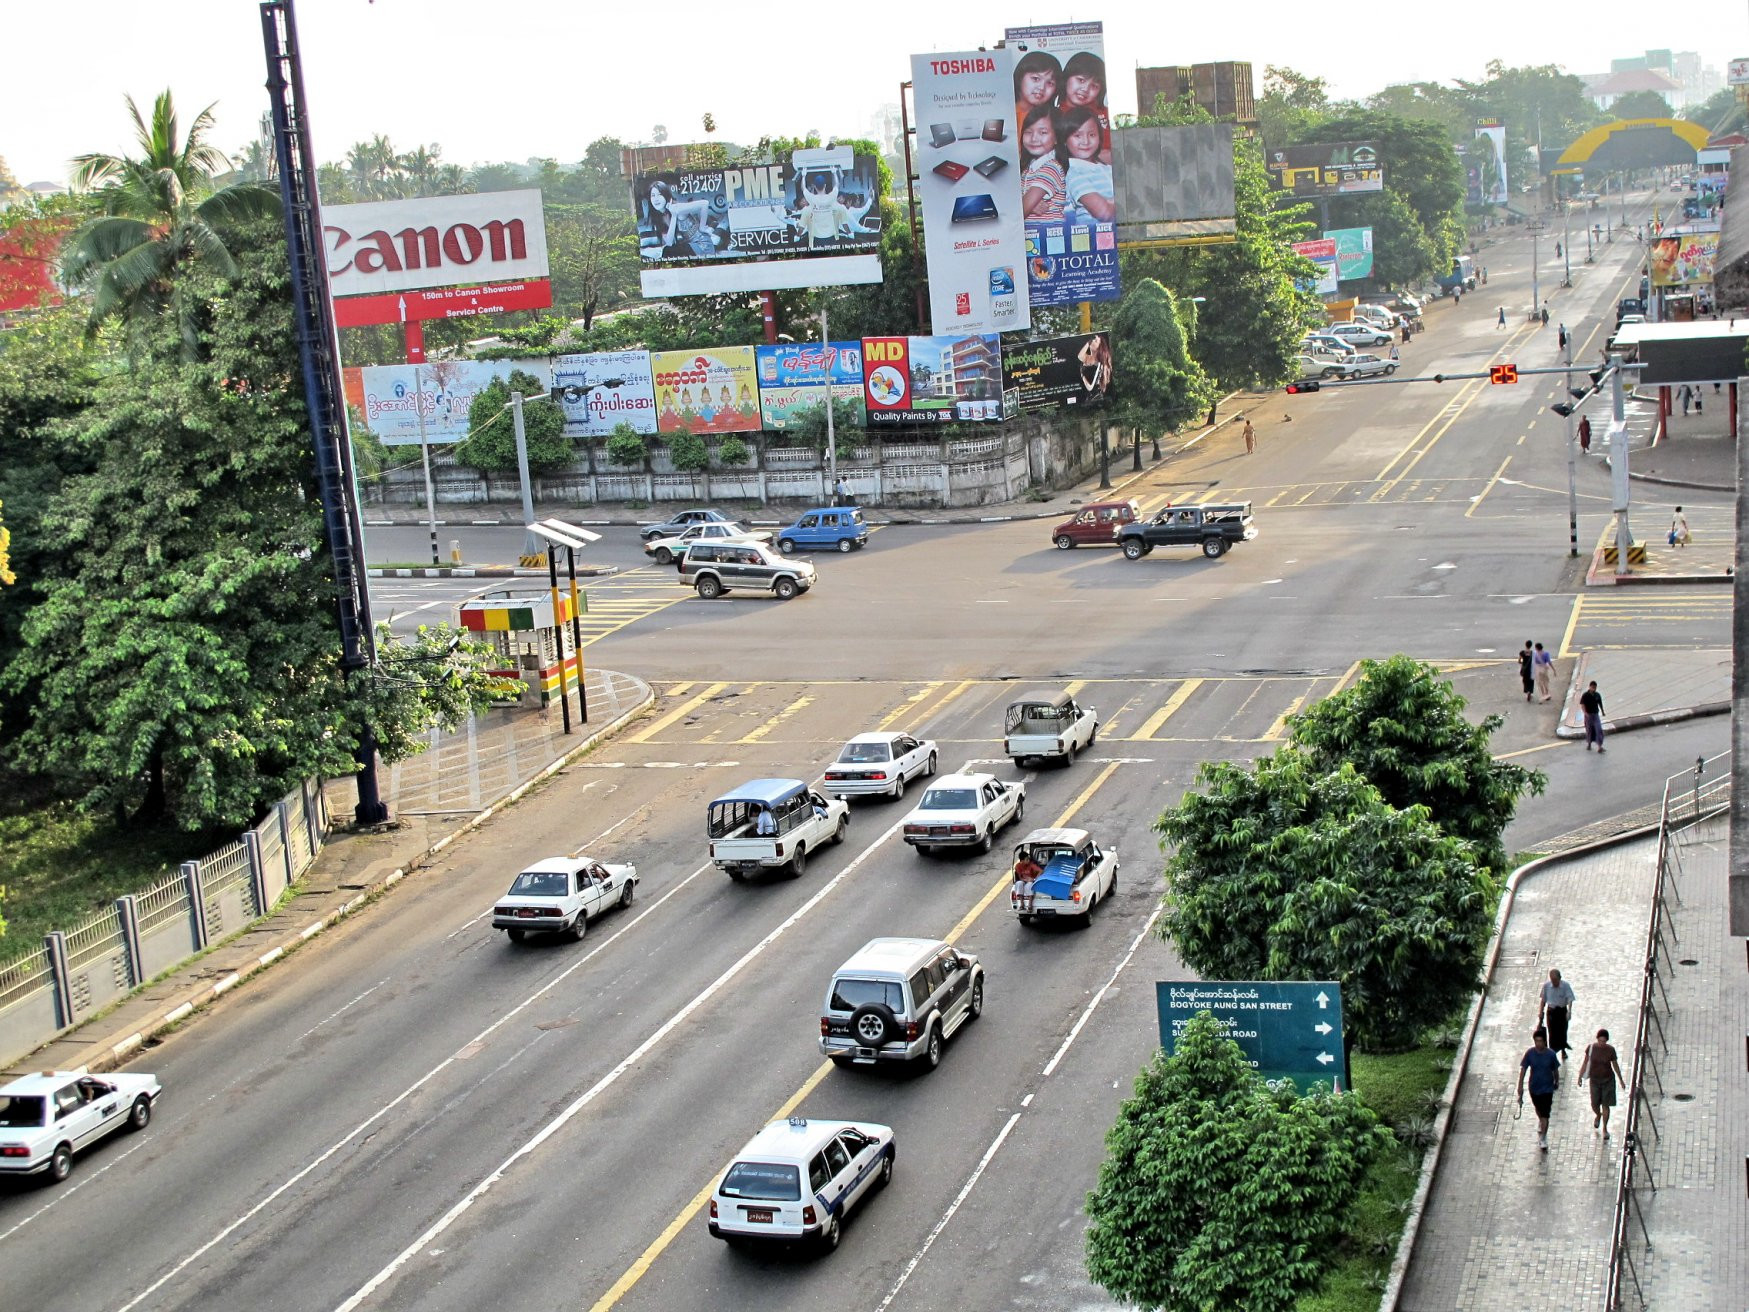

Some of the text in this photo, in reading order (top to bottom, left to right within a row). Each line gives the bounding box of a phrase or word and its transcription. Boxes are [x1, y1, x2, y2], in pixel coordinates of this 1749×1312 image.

[930, 58, 995, 75] TOSHIBA
[724, 166, 786, 202] PME
[730, 229, 788, 247] SERVICE
[954, 241, 976, 250] Satellite
[324, 218, 527, 277] Canon
[1058, 253, 1115, 271] TOTAL
[422, 284, 525, 301] 150m to Canon Showroom
[446, 305, 504, 318] Service Centre
[995, 300, 1014, 308] Faster.
[865, 342, 904, 361] MD
[1492, 365, 1517, 384] 25
[590, 392, 653, 420] ကိုးပါးဆေး
[873, 412, 901, 421] Quality
[902, 411, 926, 420] Paints
[927, 411, 936, 420] By
[1170, 1001, 1212, 1009] BOGYOKE
[1259, 1002, 1293, 1010] STREET
